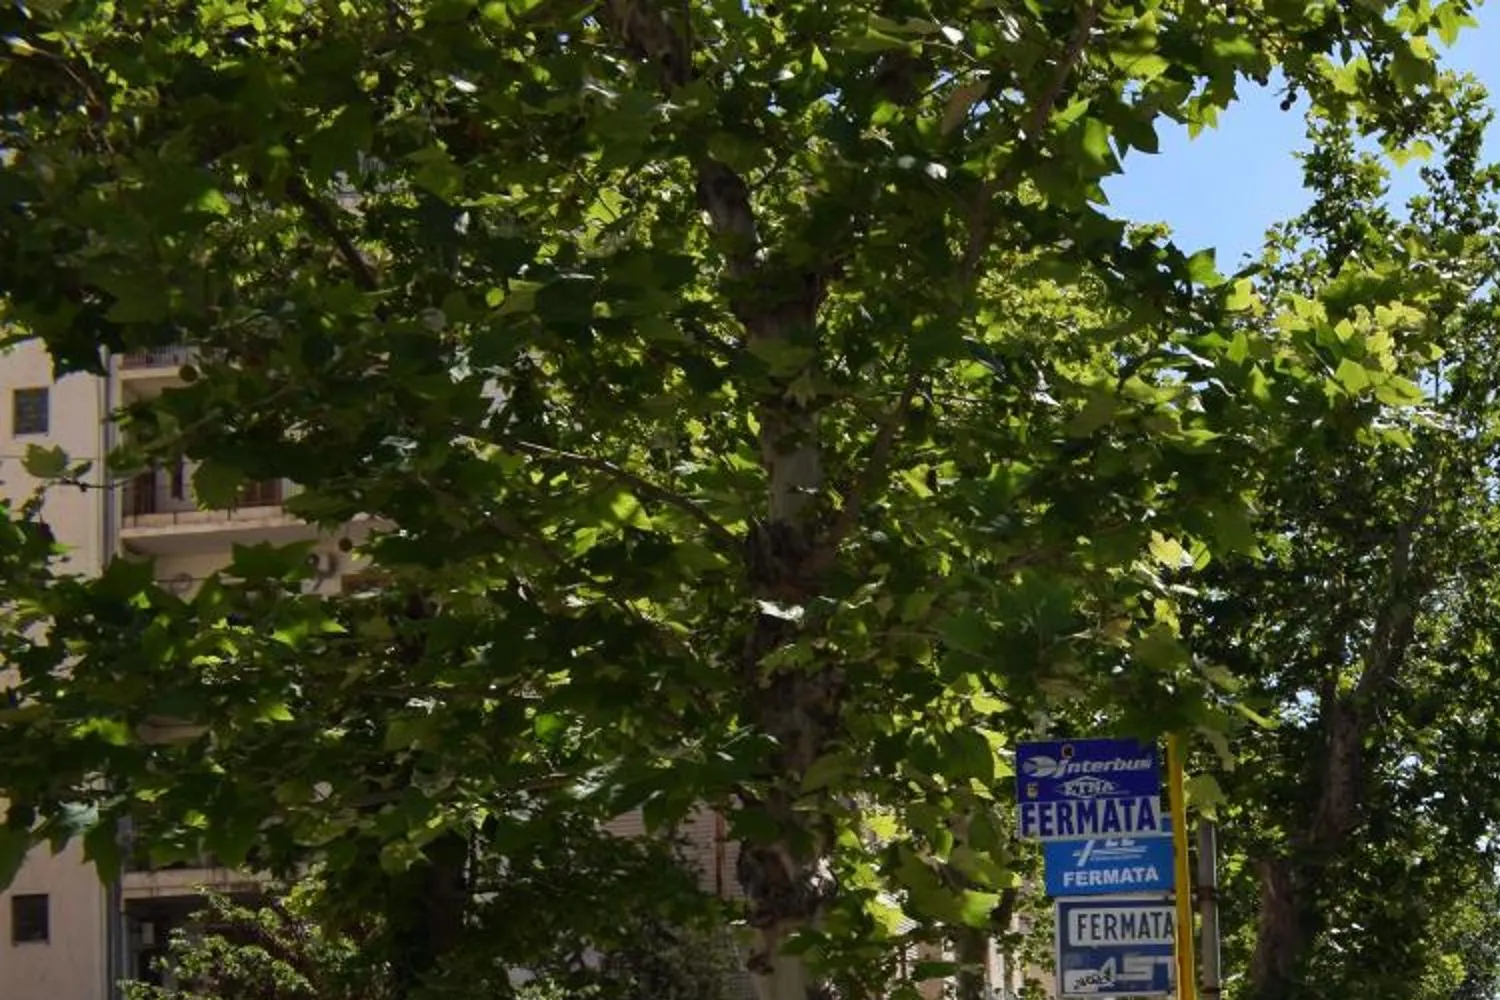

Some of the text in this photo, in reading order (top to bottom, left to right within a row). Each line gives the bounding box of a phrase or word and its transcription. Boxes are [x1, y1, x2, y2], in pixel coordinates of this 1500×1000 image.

[1020, 797, 1157, 837] FERMATA
[1062, 866, 1159, 887] FERMATA
[1077, 911, 1175, 940] FERMATA
